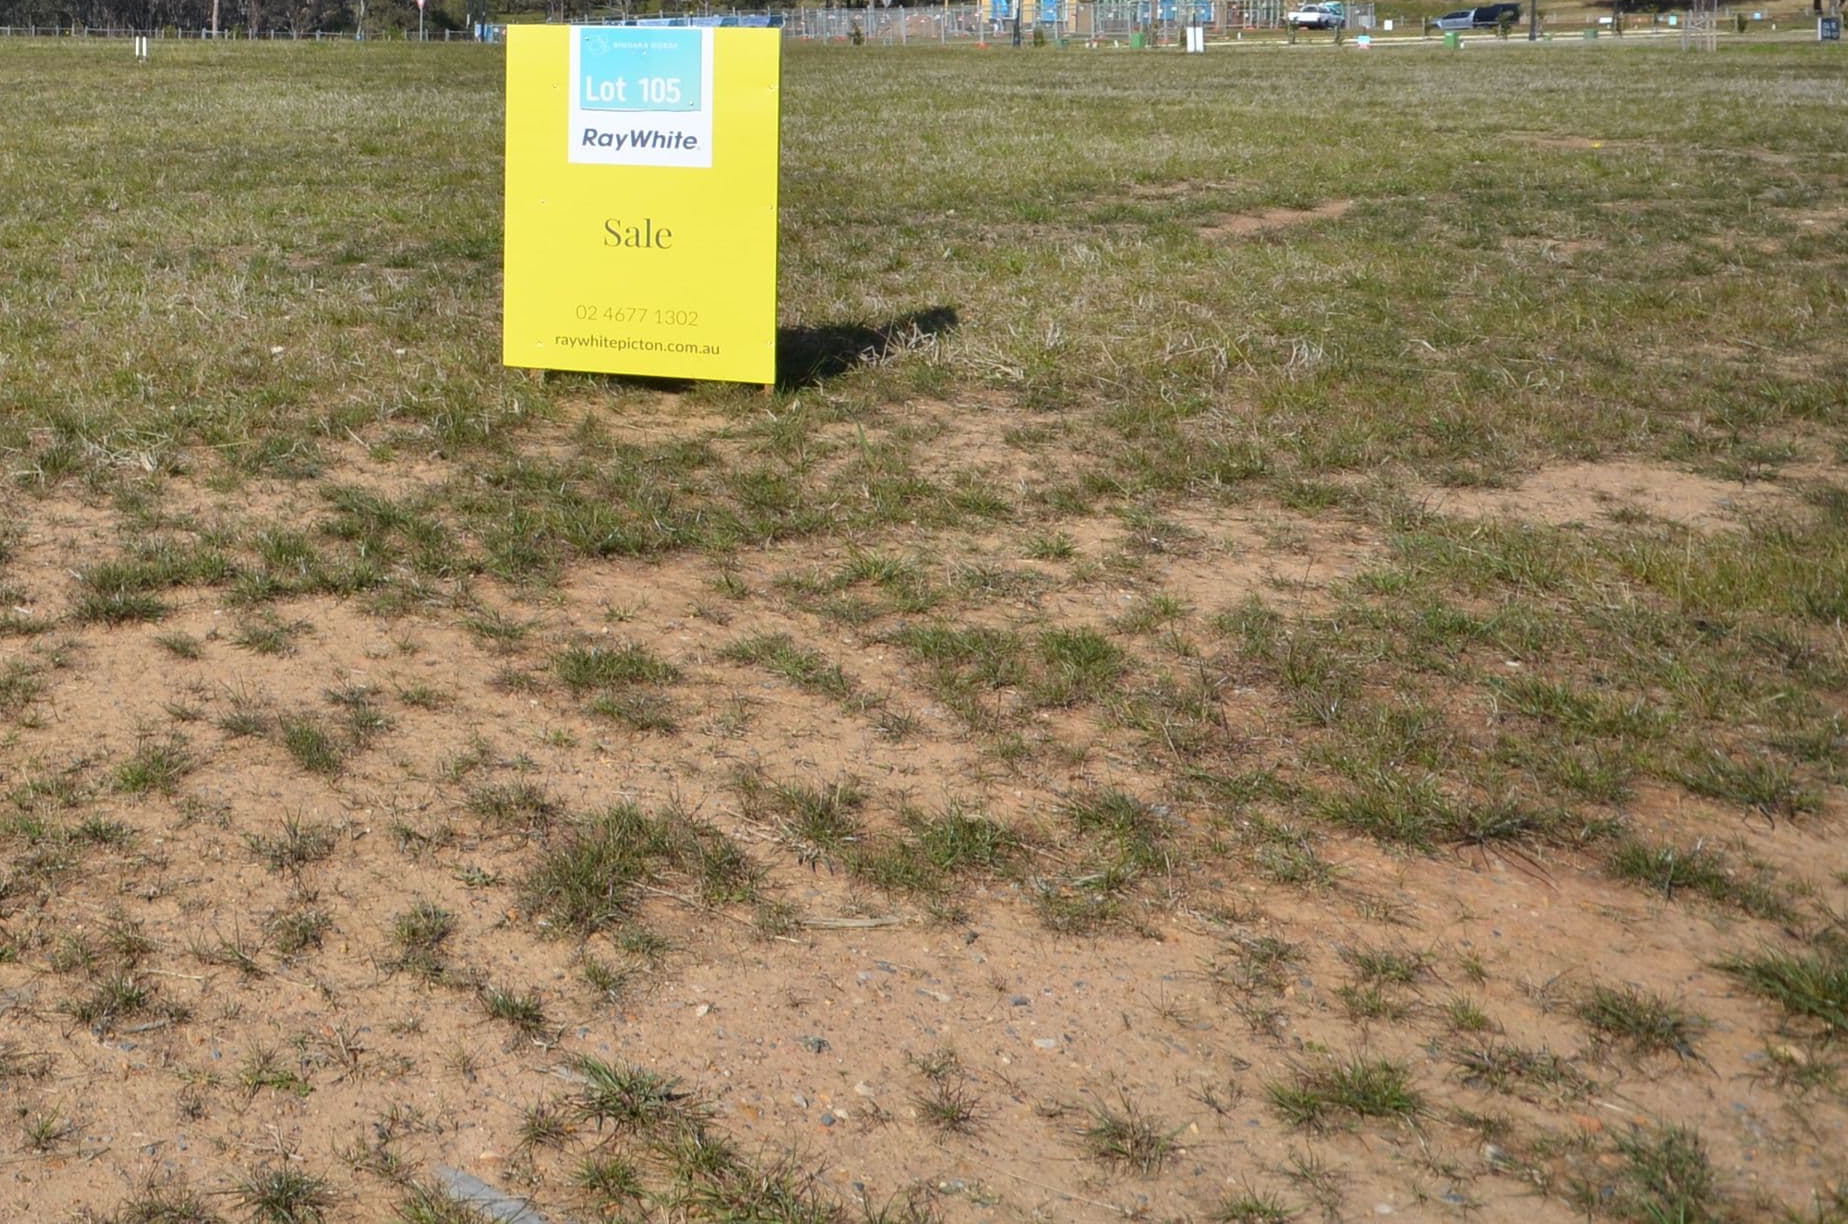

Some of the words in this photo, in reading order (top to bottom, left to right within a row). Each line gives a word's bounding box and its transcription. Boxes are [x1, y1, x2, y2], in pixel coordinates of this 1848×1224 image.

[585, 76, 627, 102] Lot
[638, 77, 681, 104] 105
[604, 217, 673, 250] Sale
[575, 304, 598, 321] 02
[603, 306, 648, 323] 4677
[654, 309, 699, 327] 1302
[555, 333, 721, 355] raywhitepicton.com.au
